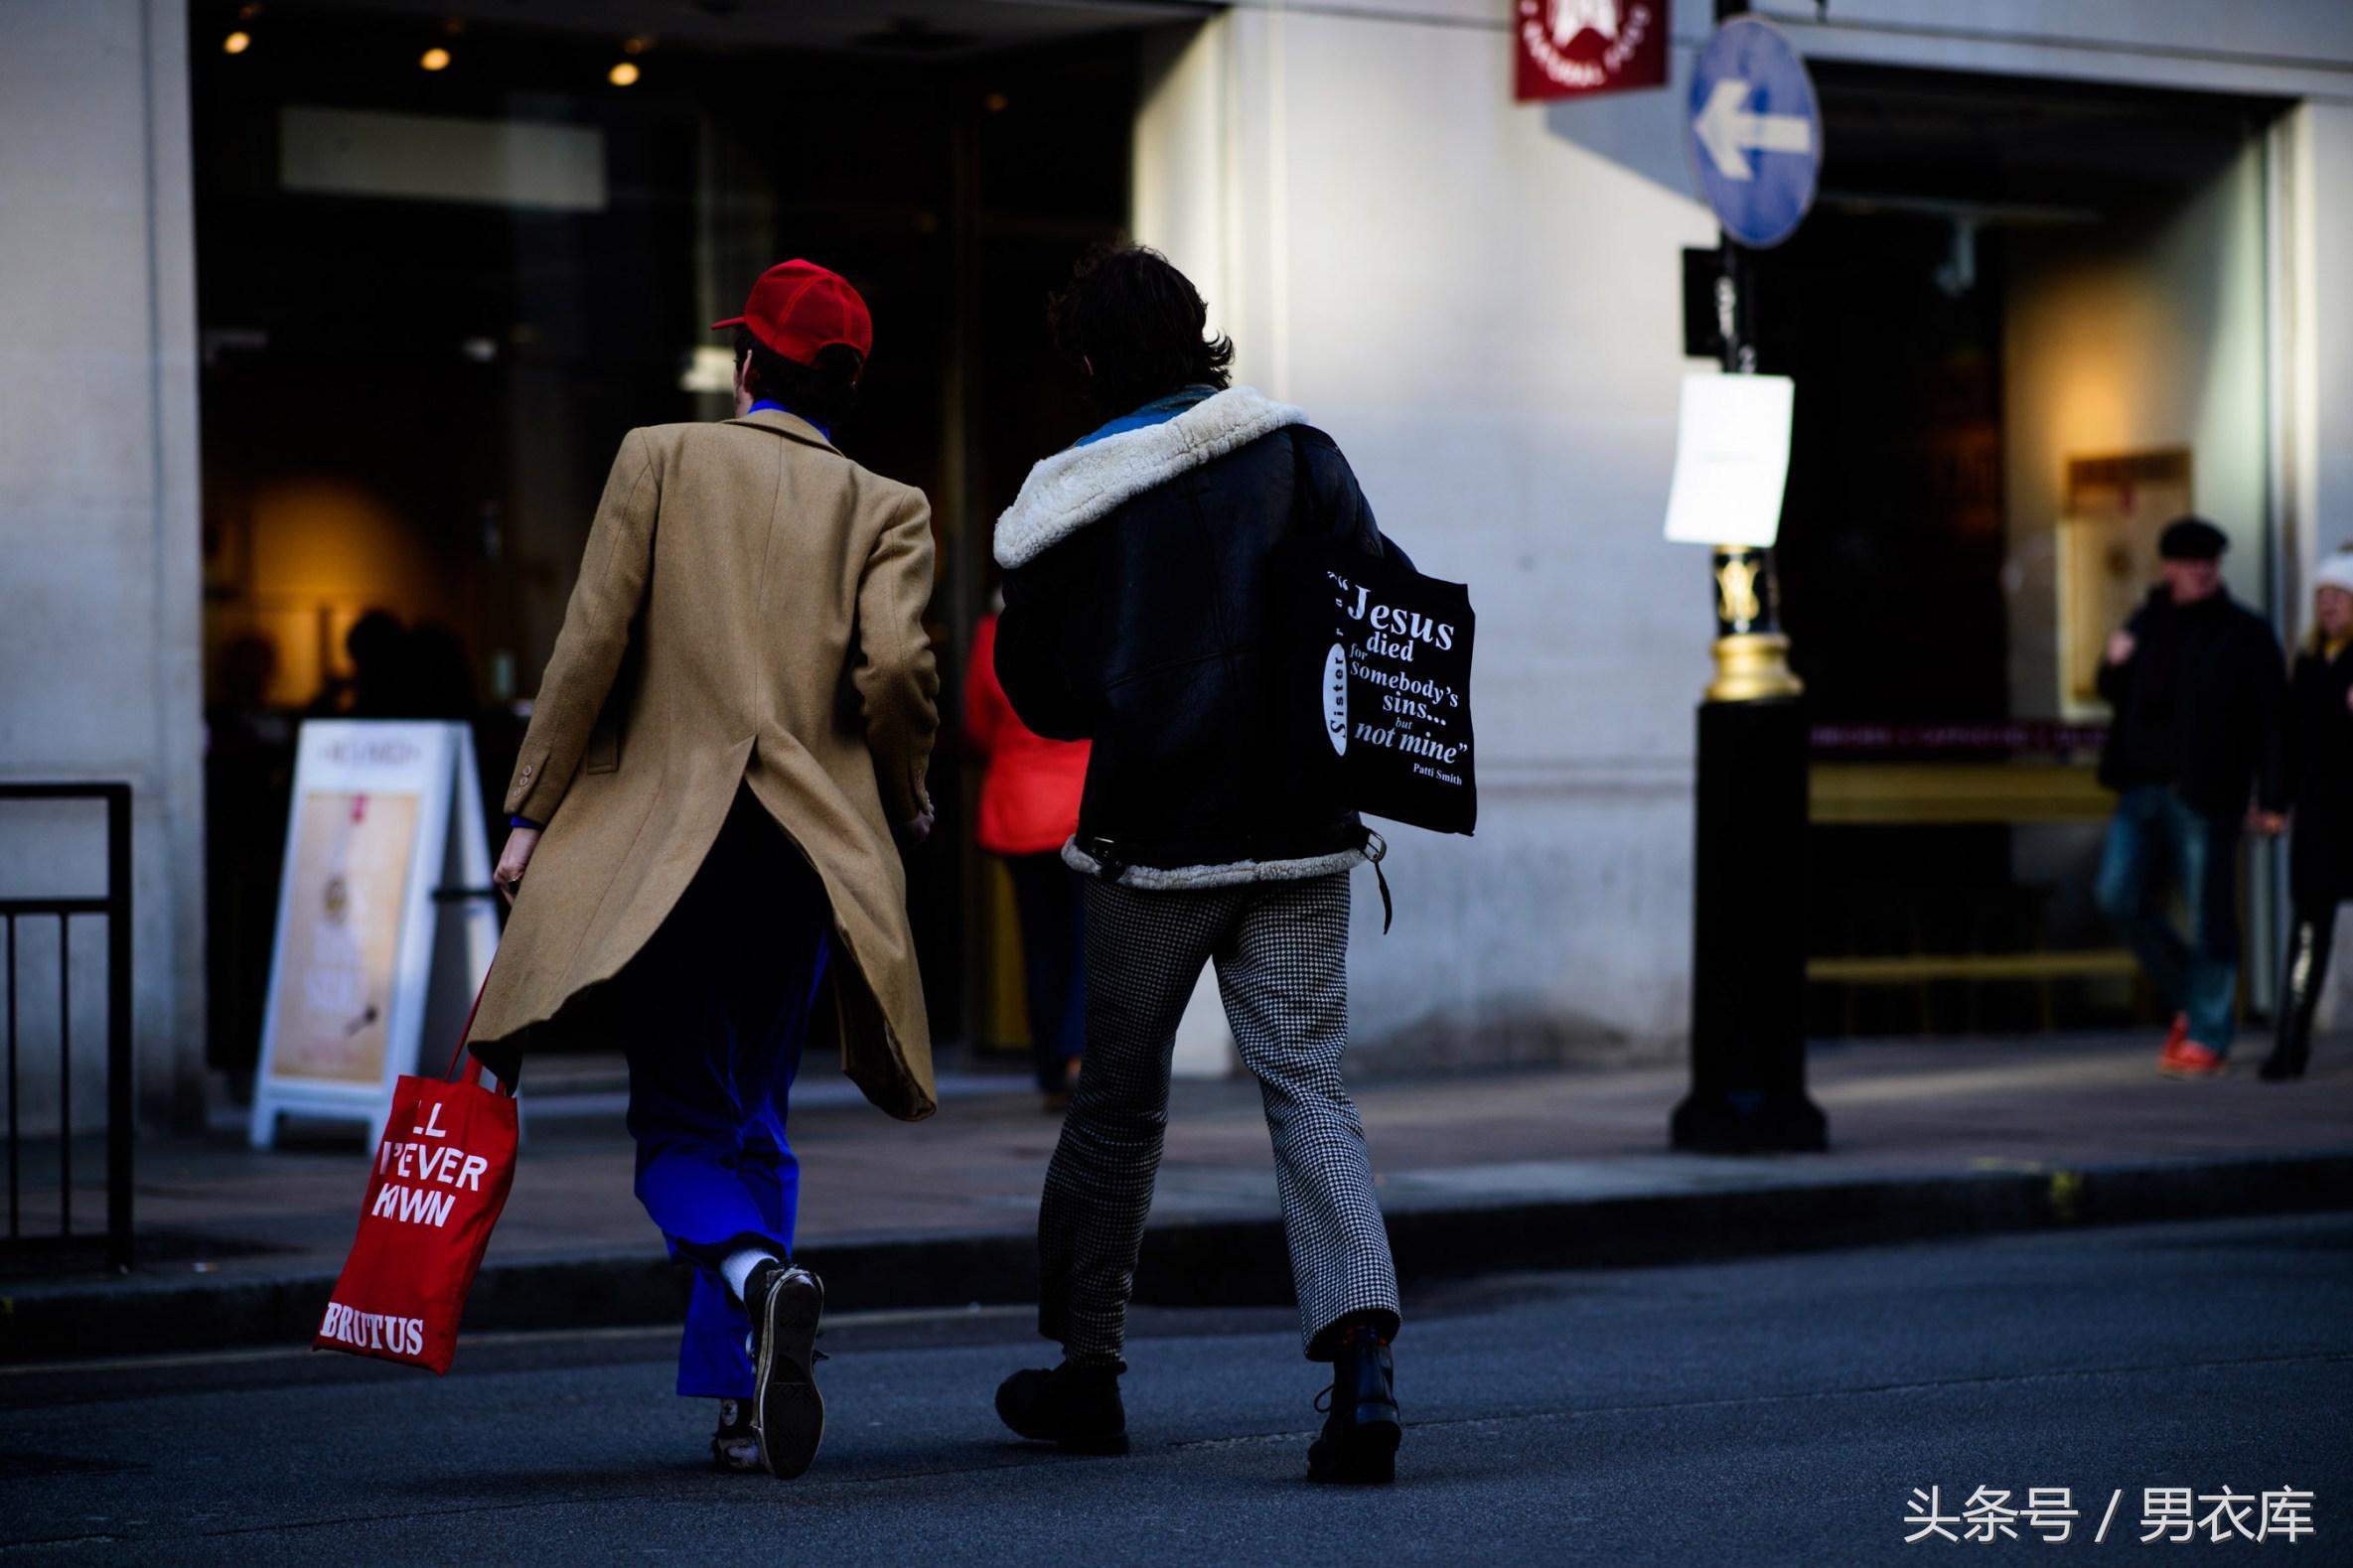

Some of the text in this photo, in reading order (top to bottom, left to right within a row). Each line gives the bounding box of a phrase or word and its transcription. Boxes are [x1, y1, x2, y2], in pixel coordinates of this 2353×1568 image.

[1350, 642, 1369, 660] for
[1366, 631, 1414, 662] died
[1329, 656, 1346, 739] Sister
[1350, 660, 1459, 708] somebody's
[1354, 722, 1397, 748] not
[1395, 716, 1414, 731] but
[1412, 762, 1463, 786] Patti Smith
[319, 1301, 424, 1356] BRUTUS
